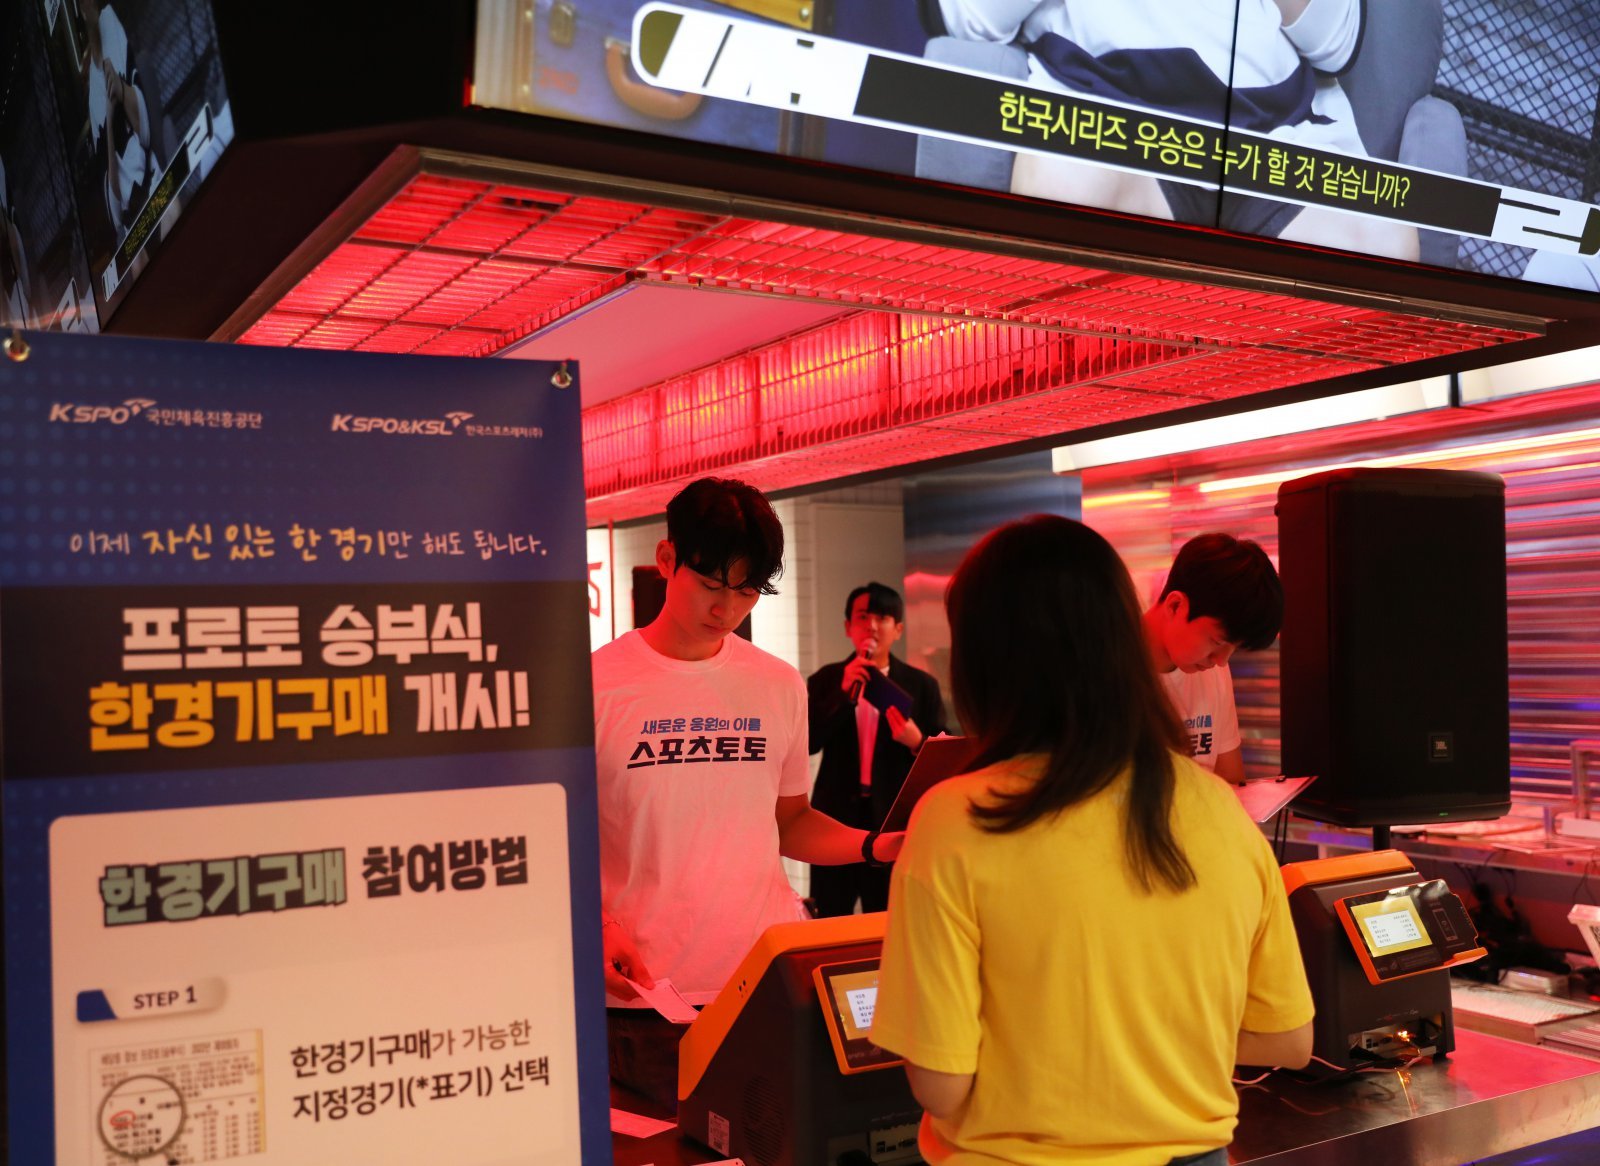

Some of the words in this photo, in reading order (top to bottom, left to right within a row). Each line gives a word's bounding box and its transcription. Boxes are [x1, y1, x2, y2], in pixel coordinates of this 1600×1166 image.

[999, 91, 1128, 151] 한국시리즈
[1134, 123, 1206, 170] 우승은
[1211, 137, 1261, 181] 누가
[1267, 147, 1290, 187] 할
[1294, 153, 1315, 193] 것
[1321, 161, 1410, 208] 같습니까?
[49, 403, 130, 425] KSPO
[146, 408, 264, 429] 국민체육진흥공단
[331, 413, 453, 436] KSPO&KSL
[70, 530, 130, 555] 이제
[142, 523, 212, 560] 자신
[225, 524, 275, 560] 있는
[288, 523, 321, 562] 한
[329, 526, 412, 561] 경기만
[421, 530, 465, 556] 해도
[473, 529, 548, 560] 됩니다.
[122, 605, 302, 671] 프로토
[319, 602, 498, 667] 승부식,
[89, 674, 388, 752] 한경기구매
[403, 670, 530, 732] 개시!
[641, 718, 687, 734] 새로운
[690, 717, 729, 732] 응원의
[733, 717, 761, 732] 이름
[627, 736, 767, 769] 스포츠토토
[99, 847, 347, 927] 한경기구매
[361, 835, 529, 899] 참여방법
[133, 990, 180, 1010] STEP
[186, 985, 197, 1004] 1
[290, 1029, 456, 1079] 한경기구매가
[462, 1018, 532, 1053] 가능한
[499, 1056, 550, 1094] 선택
